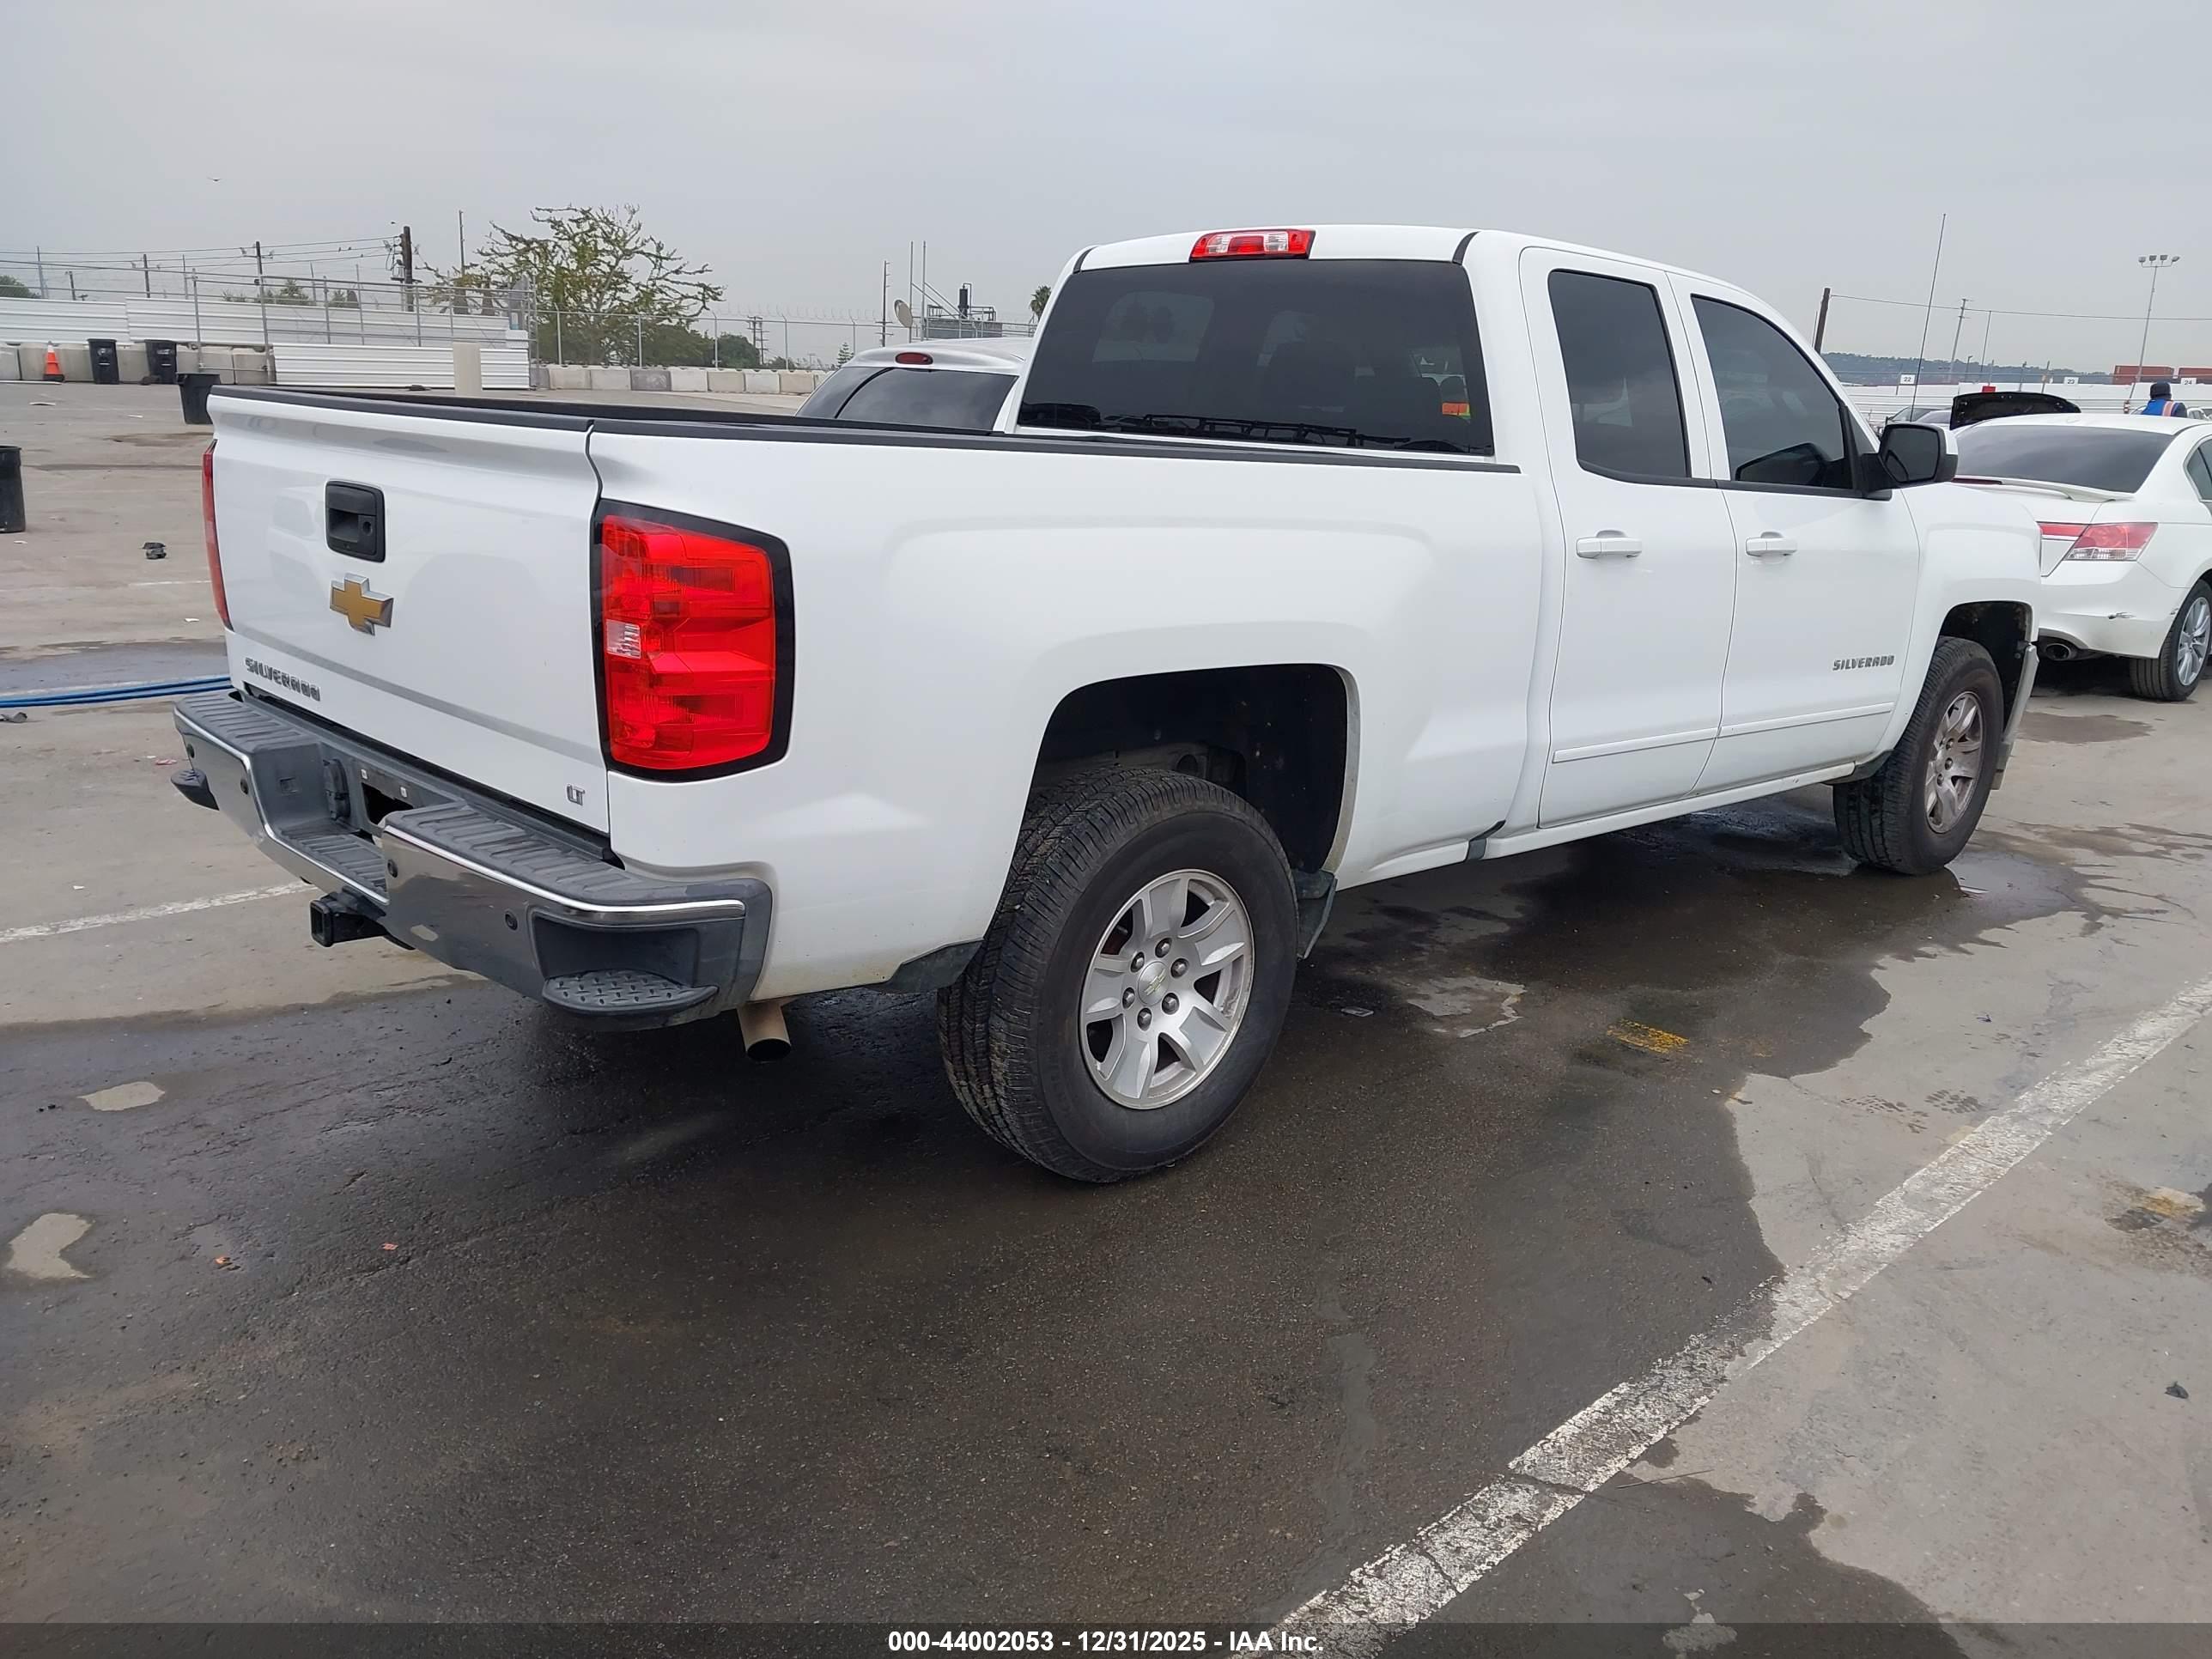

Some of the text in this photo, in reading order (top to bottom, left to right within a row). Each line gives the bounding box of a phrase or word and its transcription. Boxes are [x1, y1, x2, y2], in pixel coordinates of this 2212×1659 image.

[1832, 654, 1895, 671] SILVERADO
[244, 657, 321, 702] SILVERADO
[566, 783, 586, 806] LT
